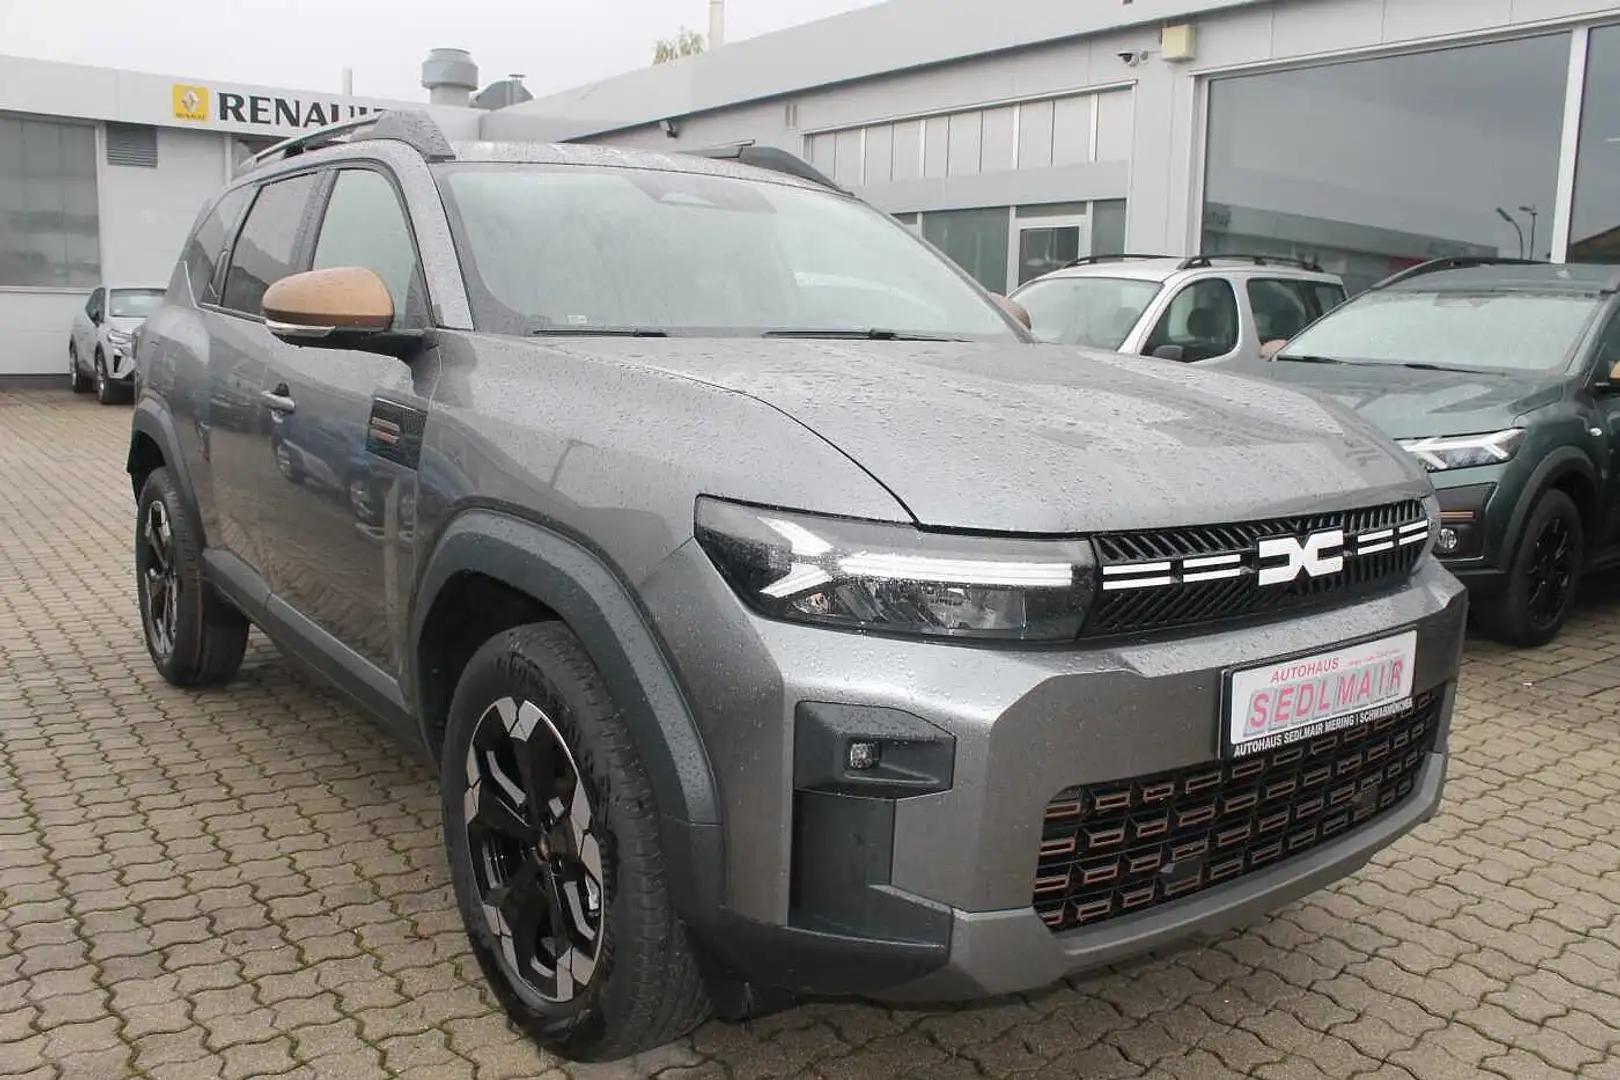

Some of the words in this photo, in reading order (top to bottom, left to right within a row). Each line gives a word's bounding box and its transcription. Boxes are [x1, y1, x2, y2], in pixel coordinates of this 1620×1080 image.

[1270, 656, 1340, 684] AUTOHAUS
[1248, 656, 1405, 729] SEDLMAIR
[1233, 734, 1282, 758] AUTOHAUS
[1283, 722, 1323, 743] SEDLMAIR
[1324, 714, 1354, 733] MERING
